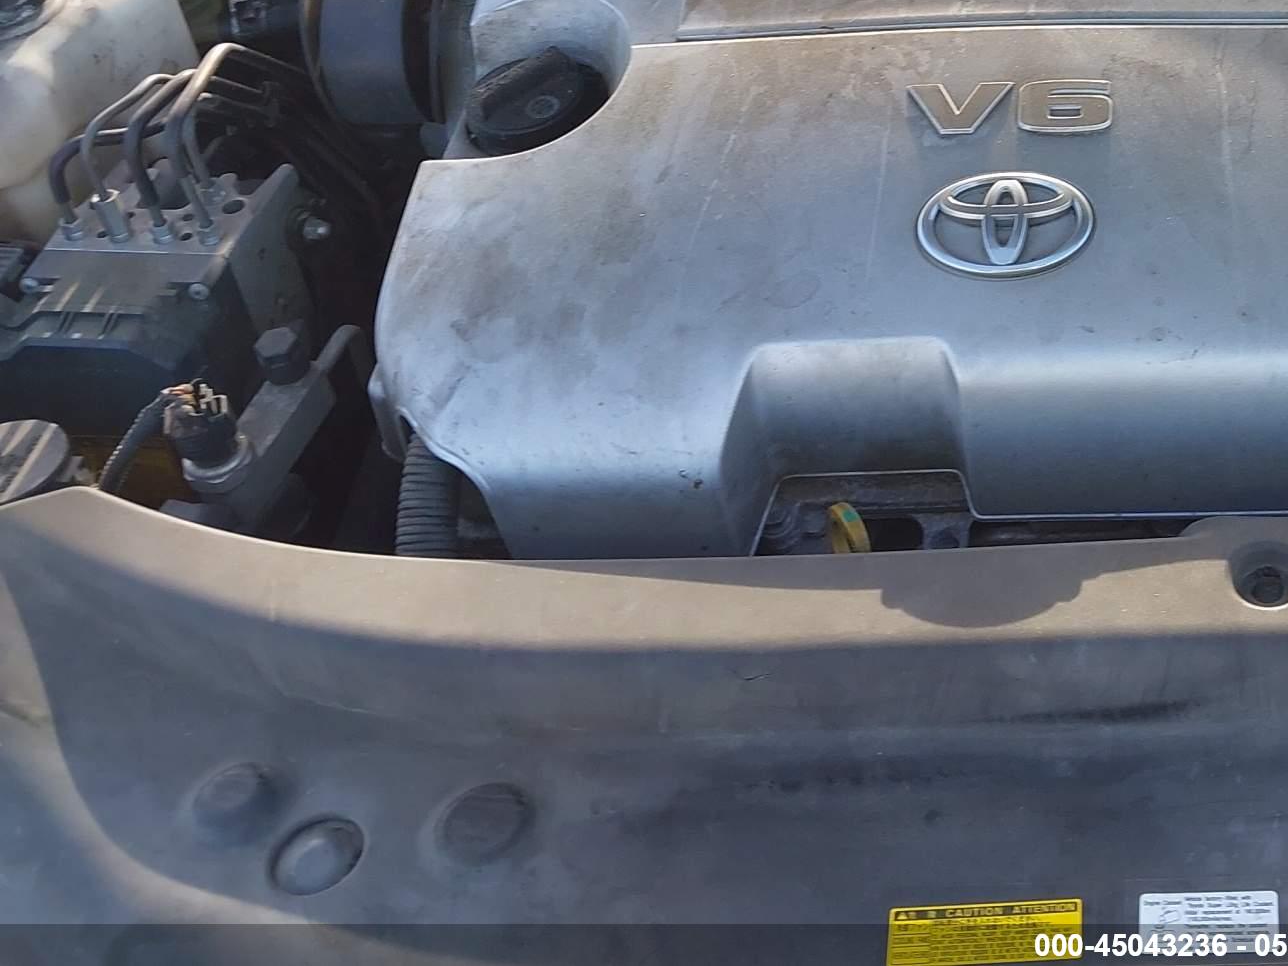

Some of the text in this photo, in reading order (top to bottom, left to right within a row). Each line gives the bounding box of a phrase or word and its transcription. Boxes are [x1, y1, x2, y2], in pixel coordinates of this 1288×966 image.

[907, 79, 1114, 135] V6
[944, 906, 1004, 918] CAUTION
[1011, 902, 1077, 915] ATTENTION
